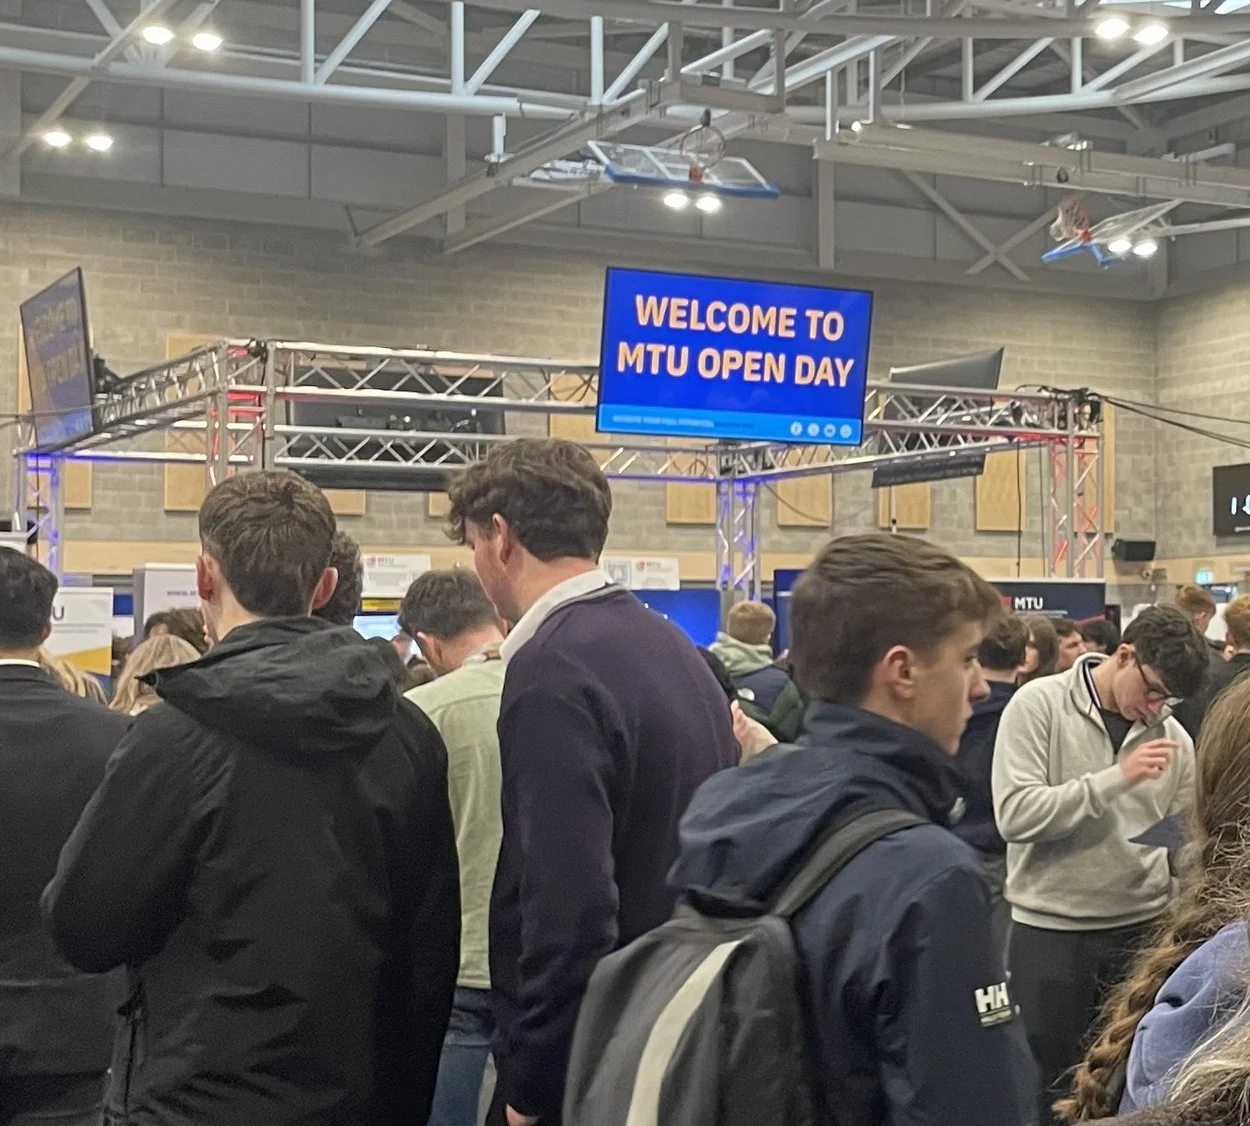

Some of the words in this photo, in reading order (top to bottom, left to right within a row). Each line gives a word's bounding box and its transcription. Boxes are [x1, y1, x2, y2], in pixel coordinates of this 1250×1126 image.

[634, 294, 797, 338] WELCOME
[805, 309, 845, 341] TO
[616, 341, 689, 376] MTU
[697, 347, 786, 383] OPEN
[793, 355, 855, 388] DAY
[1014, 596, 1044, 610] MTU
[974, 981, 1010, 1013] HH
